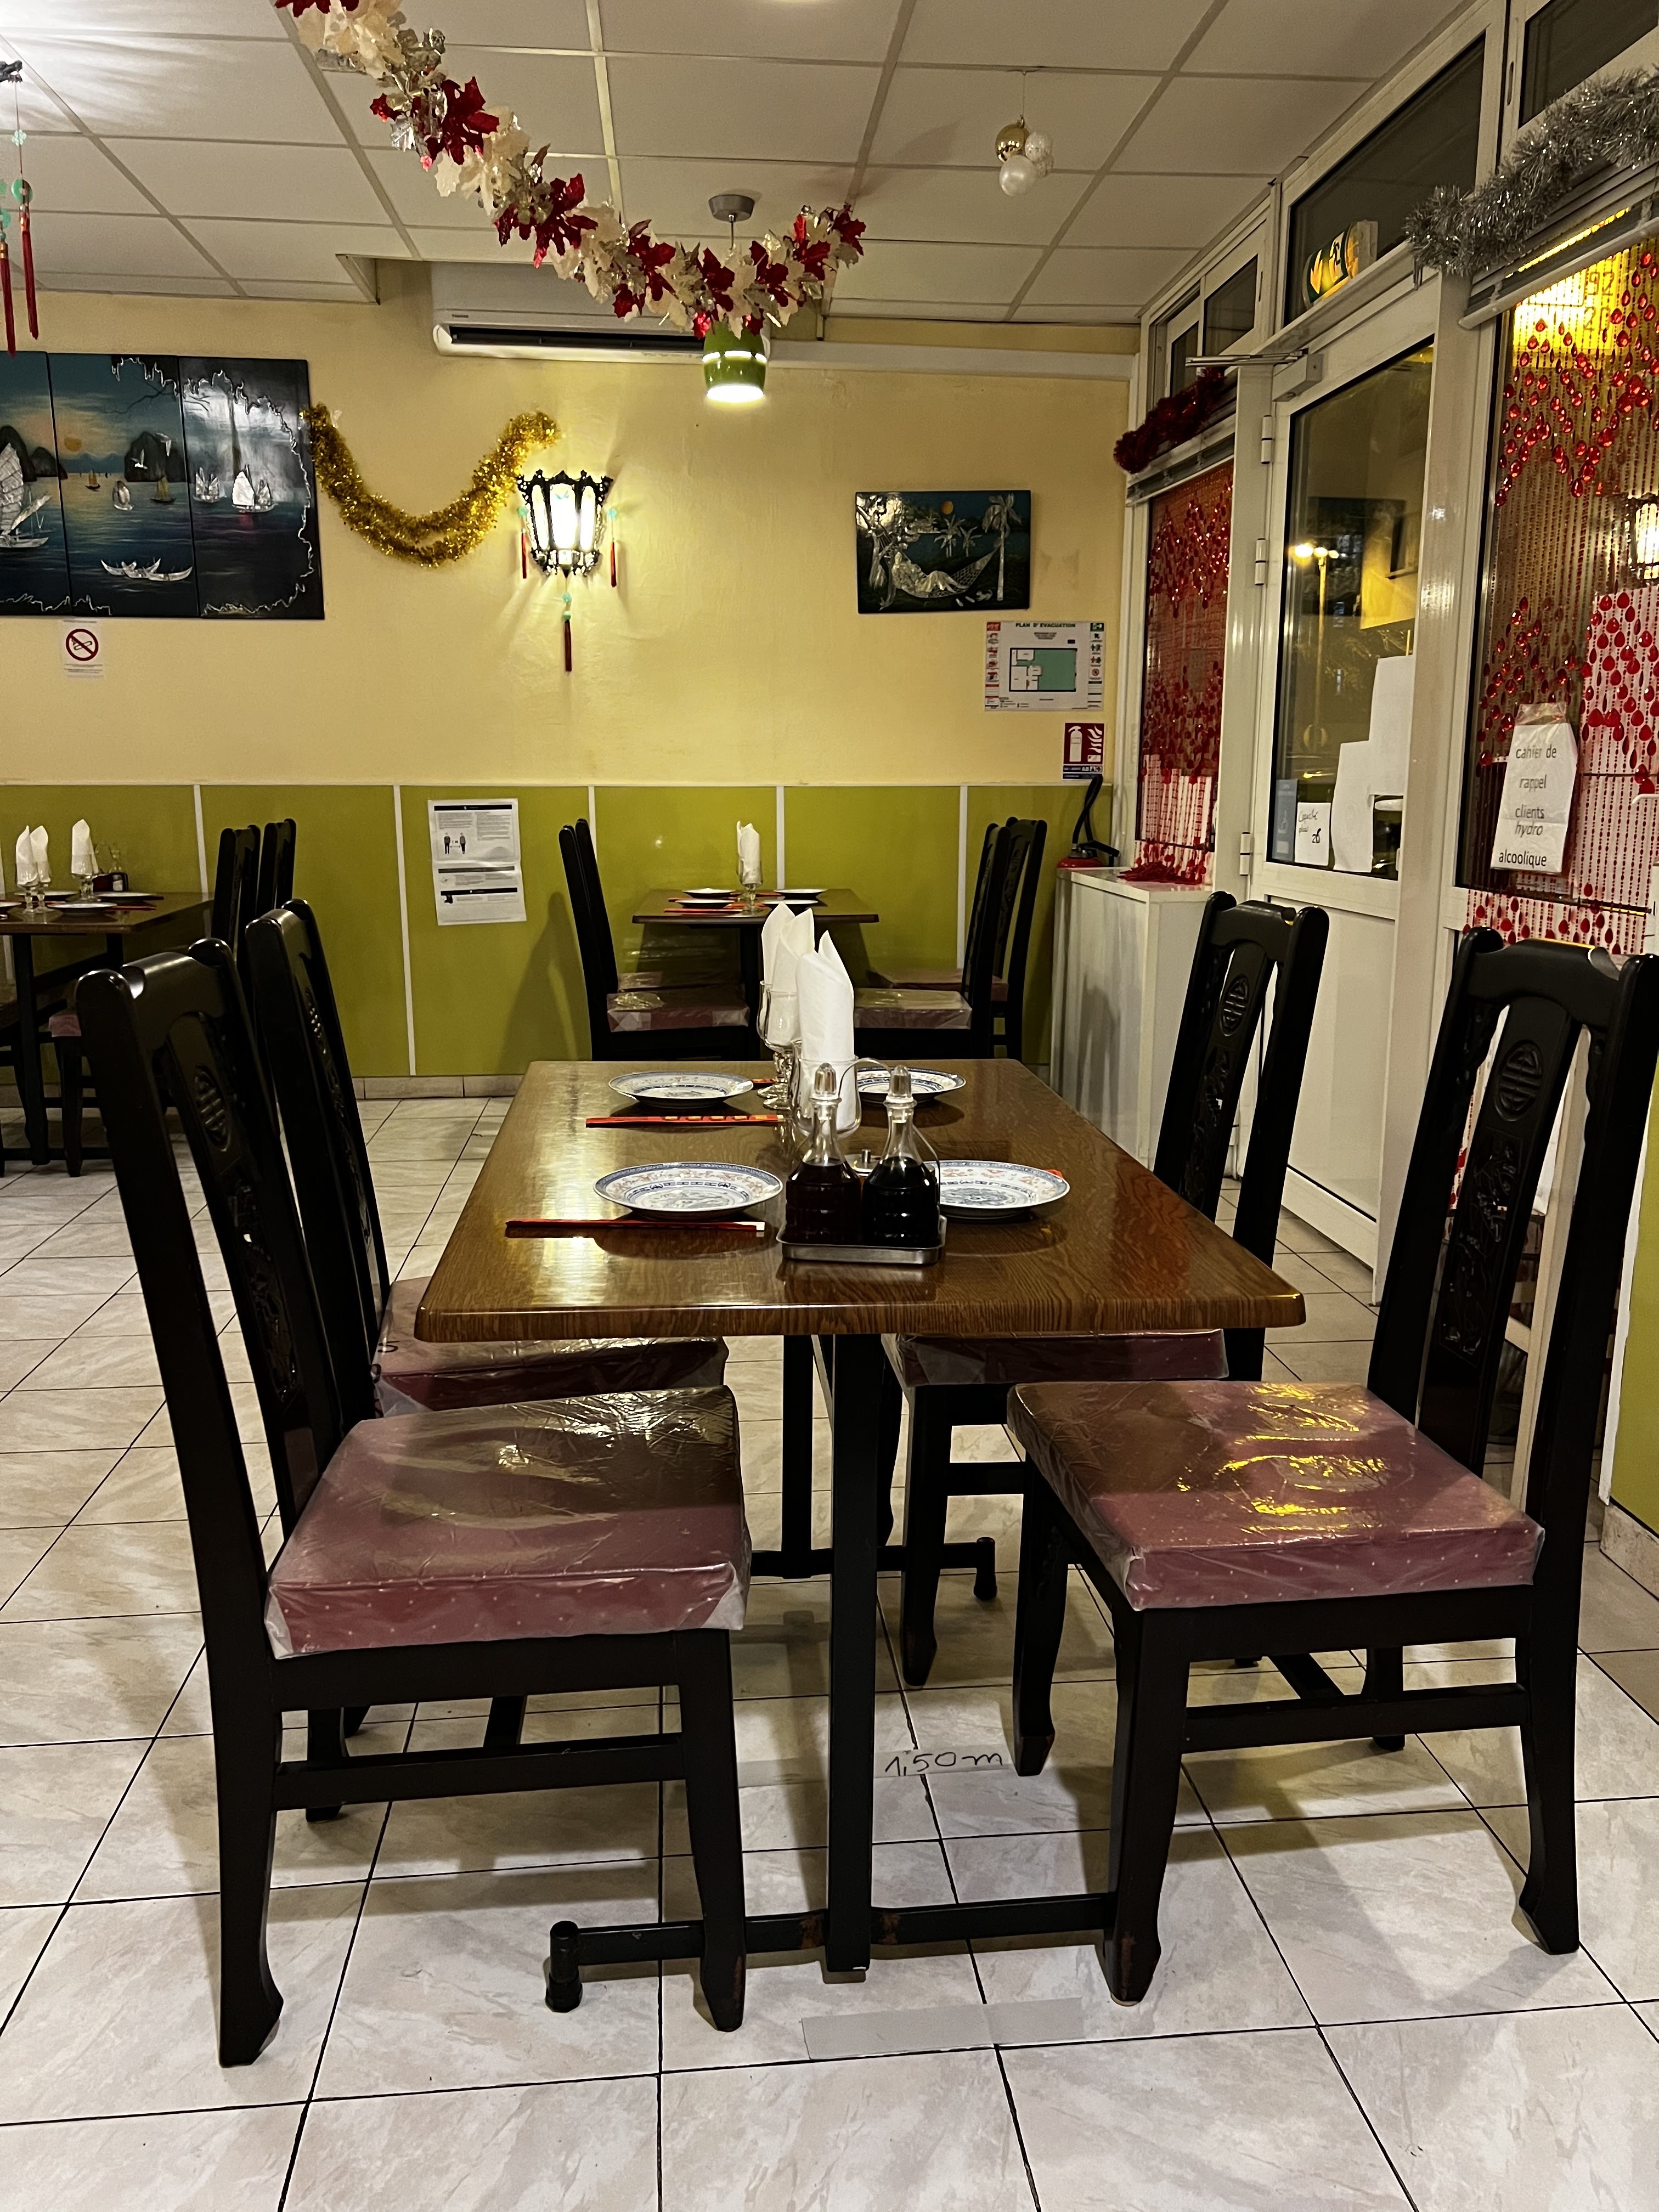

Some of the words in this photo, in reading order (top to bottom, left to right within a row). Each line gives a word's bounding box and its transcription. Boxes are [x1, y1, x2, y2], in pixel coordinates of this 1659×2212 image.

[1588, 272, 1615, 296] 92
[1516, 744, 1543, 759] cahier
[1546, 743, 1557, 758] de
[1519, 774, 1547, 792] rappel
[1515, 804, 1545, 819] clients
[1515, 820, 1544, 838] hydro
[1499, 849, 1547, 869] alcoolique
